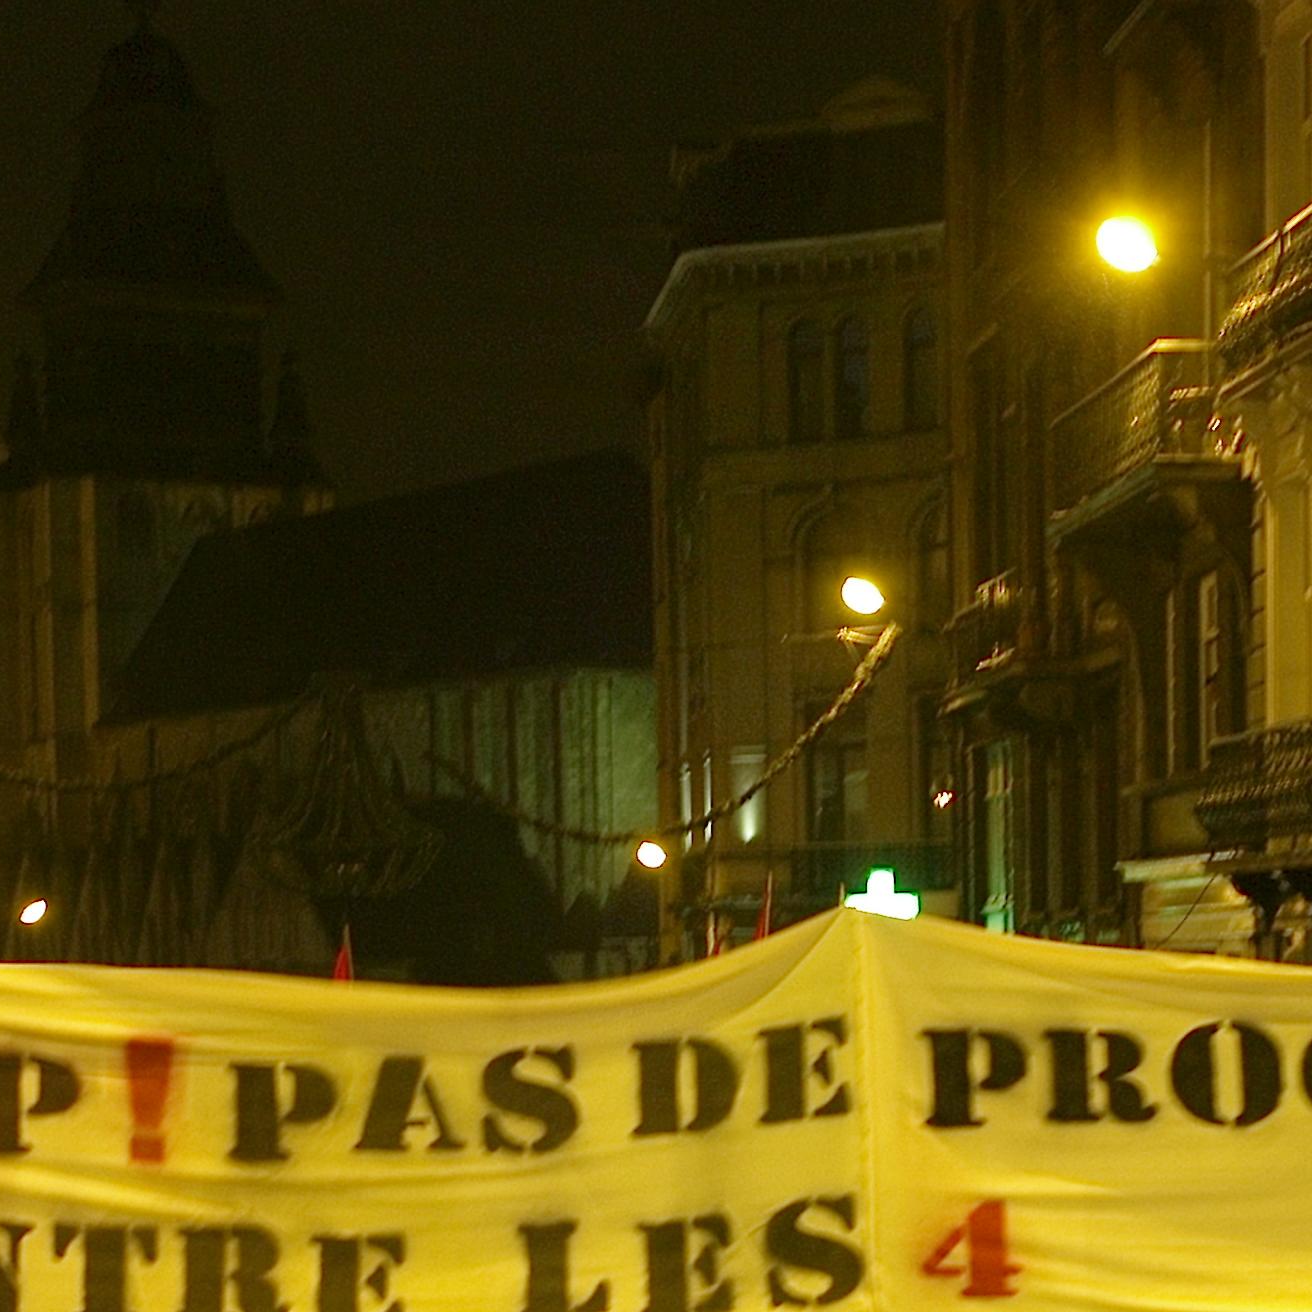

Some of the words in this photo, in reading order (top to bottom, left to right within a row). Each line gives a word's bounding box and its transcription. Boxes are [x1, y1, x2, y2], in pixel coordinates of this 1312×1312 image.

[226, 1043, 581, 1163] PAS
[631, 1013, 853, 1138] DE
[921, 1198, 1023, 1298] 4
